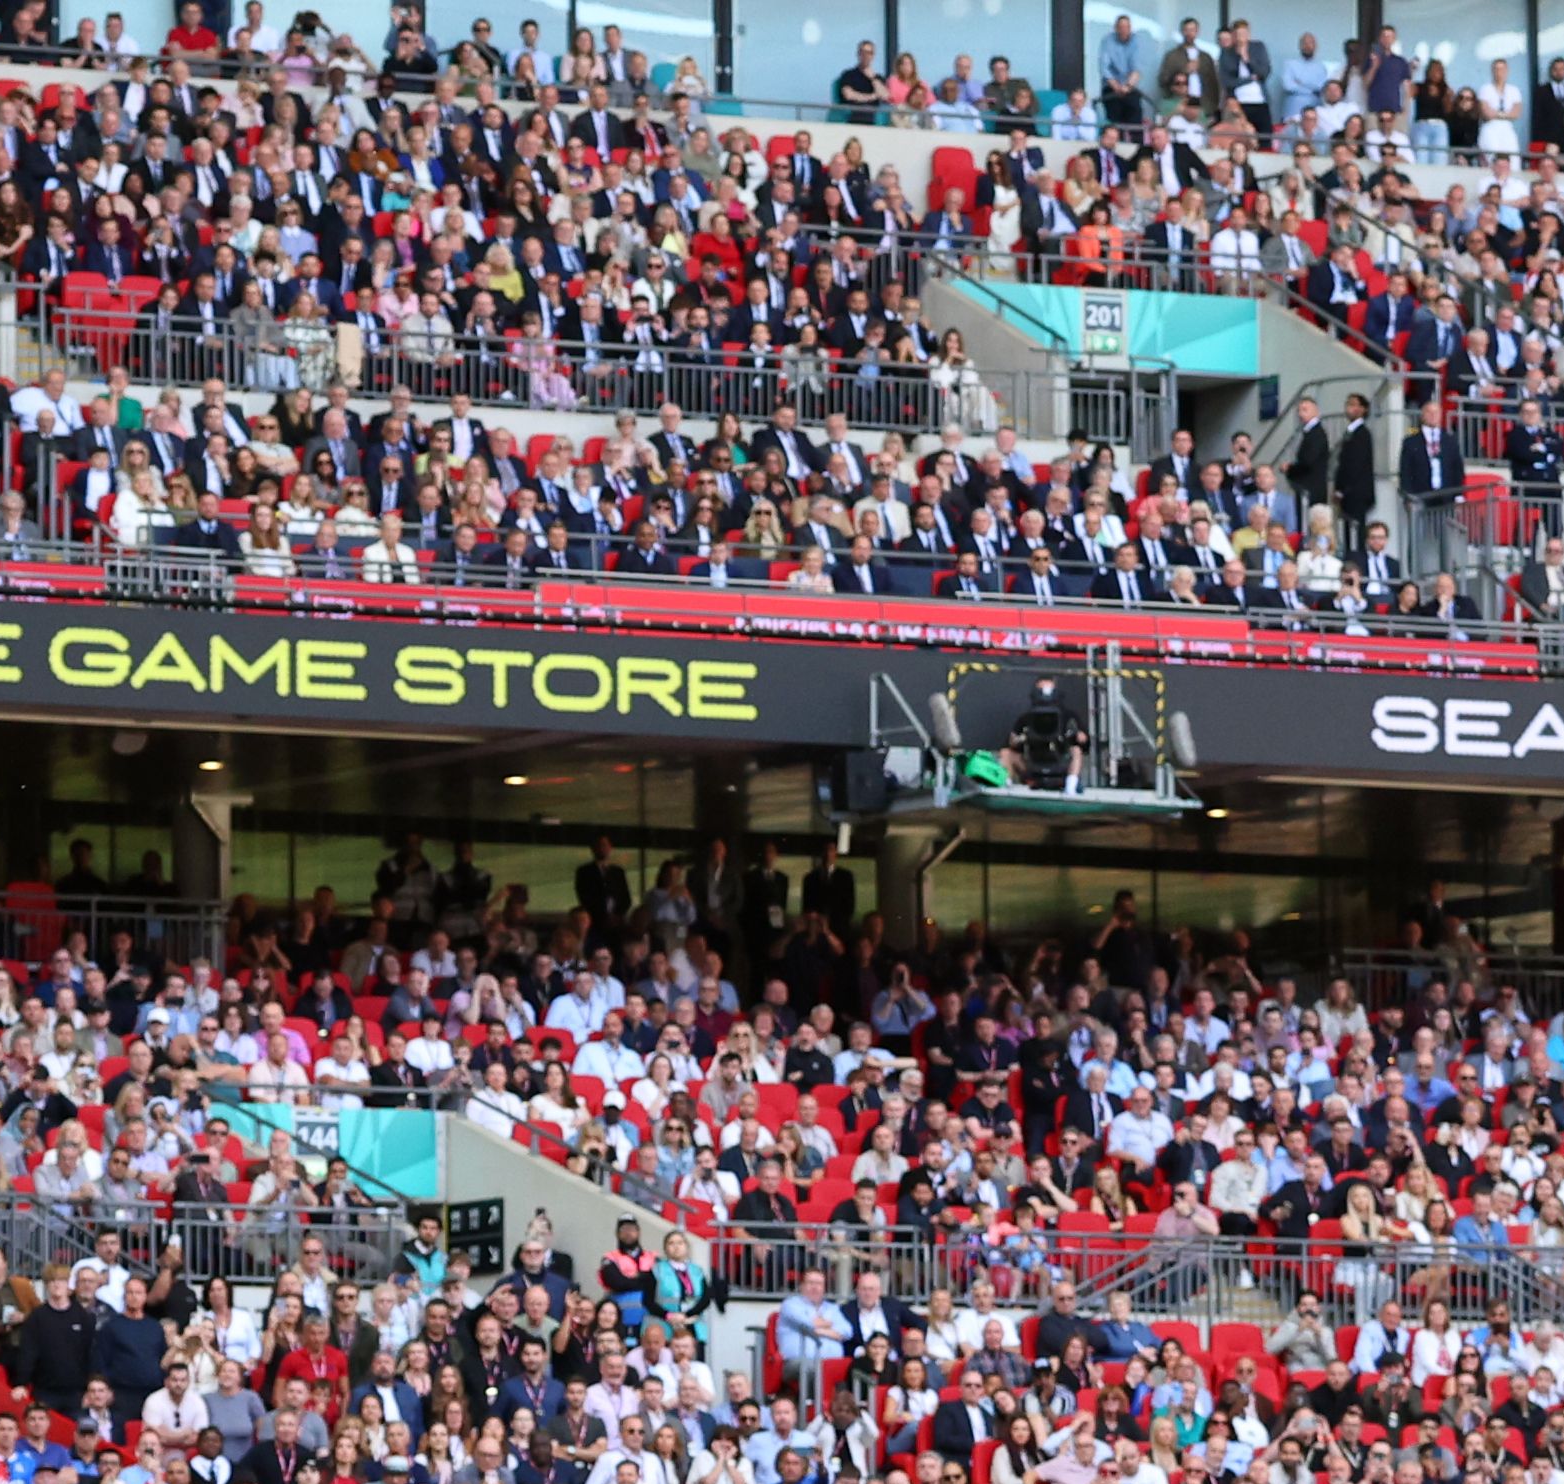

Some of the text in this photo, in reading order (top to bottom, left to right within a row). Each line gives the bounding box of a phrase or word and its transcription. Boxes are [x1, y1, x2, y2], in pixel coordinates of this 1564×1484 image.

[1086, 304, 1120, 328] 201
[48, 627, 368, 702] GAME
[393, 645, 759, 722] STORE
[298, 1125, 339, 1151] 144
